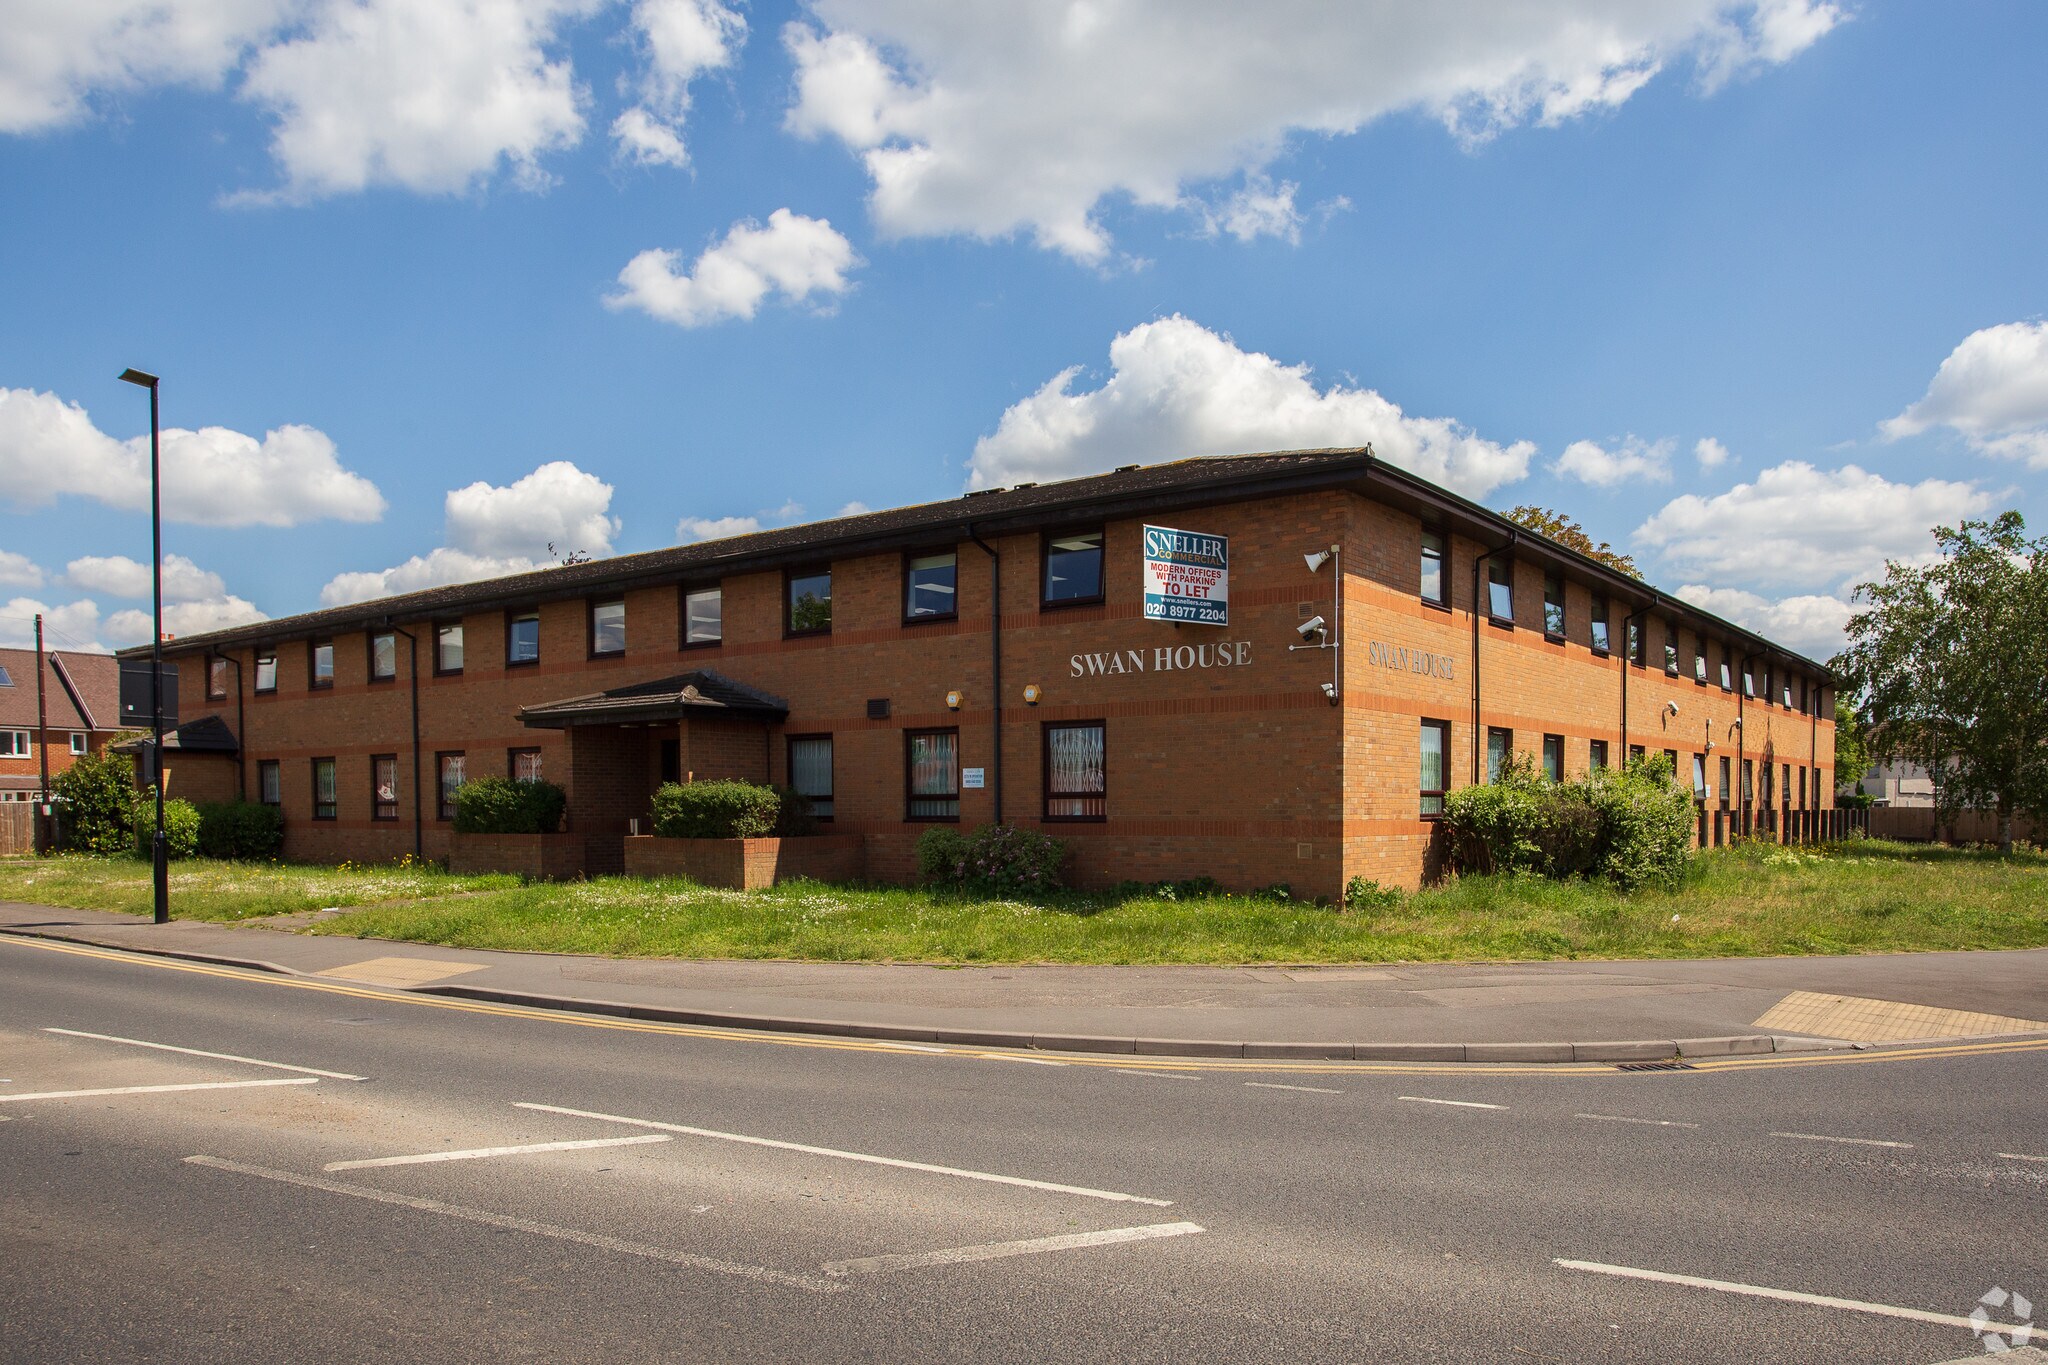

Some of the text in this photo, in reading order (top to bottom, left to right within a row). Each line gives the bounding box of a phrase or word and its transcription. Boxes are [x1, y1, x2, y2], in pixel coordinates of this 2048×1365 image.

[1146, 530, 1225, 563] SNELLER
[1158, 549, 1222, 566] COMMERCIAL
[1150, 562, 1222, 578] MODERN OFFICES
[1156, 572, 1216, 586] WITH PARKING
[1162, 582, 1210, 598] TO LET
[1160, 596, 1212, 607] www.snellers.com
[1146, 603, 1226, 622] 020 8977 2204
[1070, 641, 1253, 678] SWAN HOUSE
[1368, 640, 1455, 681] SWAN HOUSE
